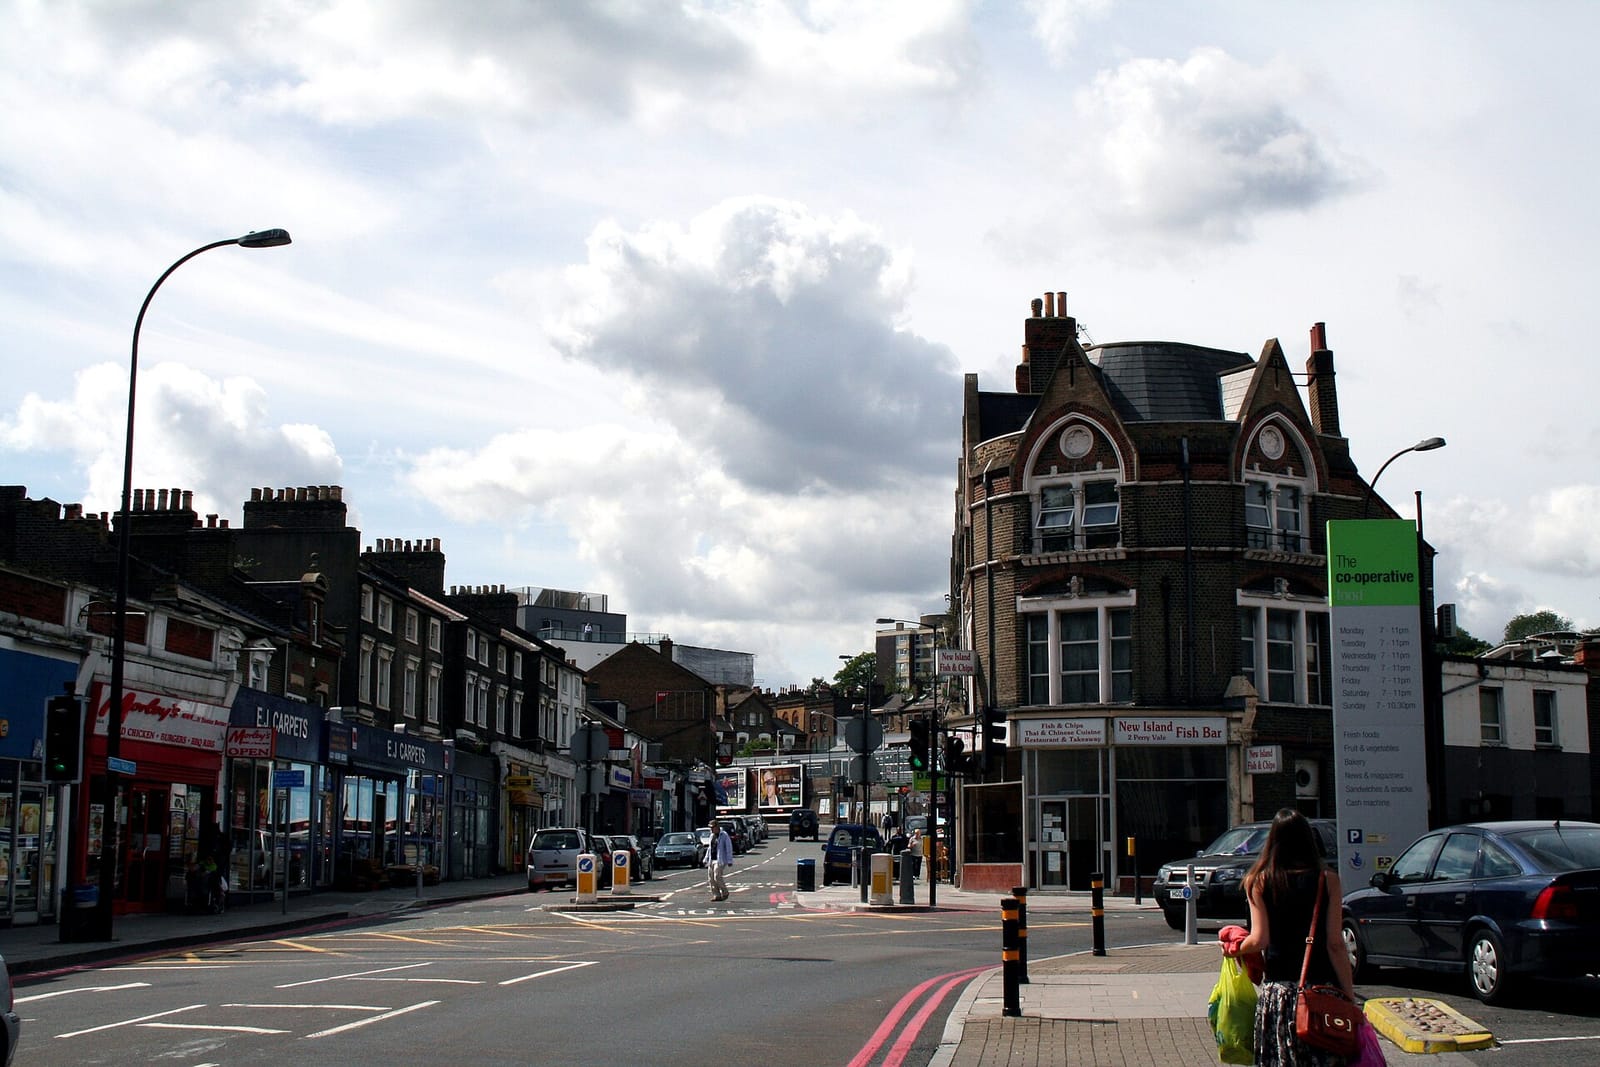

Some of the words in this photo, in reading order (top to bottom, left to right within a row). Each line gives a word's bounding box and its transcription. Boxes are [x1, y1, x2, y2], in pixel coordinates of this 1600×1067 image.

[1336, 555, 1357, 568] The
[1336, 570, 1414, 585] co-operative
[1337, 589, 1364, 601] food
[1340, 627, 1364, 636] Monday
[1341, 640, 1366, 648] Tuesday
[942, 652, 953, 660] New
[955, 652, 970, 660] Island
[940, 663, 950, 671] Fish
[952, 663, 957, 671] &
[958, 663, 973, 672] Chips
[1342, 665, 1370, 673] Thursday
[1342, 677, 1360, 685] Friday
[1342, 690, 1369, 698] Saturday
[1343, 702, 1365, 710] Sunday
[272, 711, 308, 739] CARPETS
[1119, 721, 1140, 732] New
[1143, 721, 1173, 732] Island
[127, 728, 155, 739] CHICKEN
[160, 733, 187, 744] BURGERS
[1176, 726, 1199, 738] Fish
[1203, 726, 1222, 738] Bar
[228, 748, 269, 756] OPEN
[399, 742, 426, 765] CARPETS
[1249, 750, 1258, 758] New
[1260, 748, 1273, 758] Island
[1366, 745, 1400, 753] vegetables
[1248, 761, 1257, 770] Fish
[1263, 760, 1276, 770] Chips
[1344, 759, 1366, 767] Bakery
[1371, 772, 1404, 780] magazines
